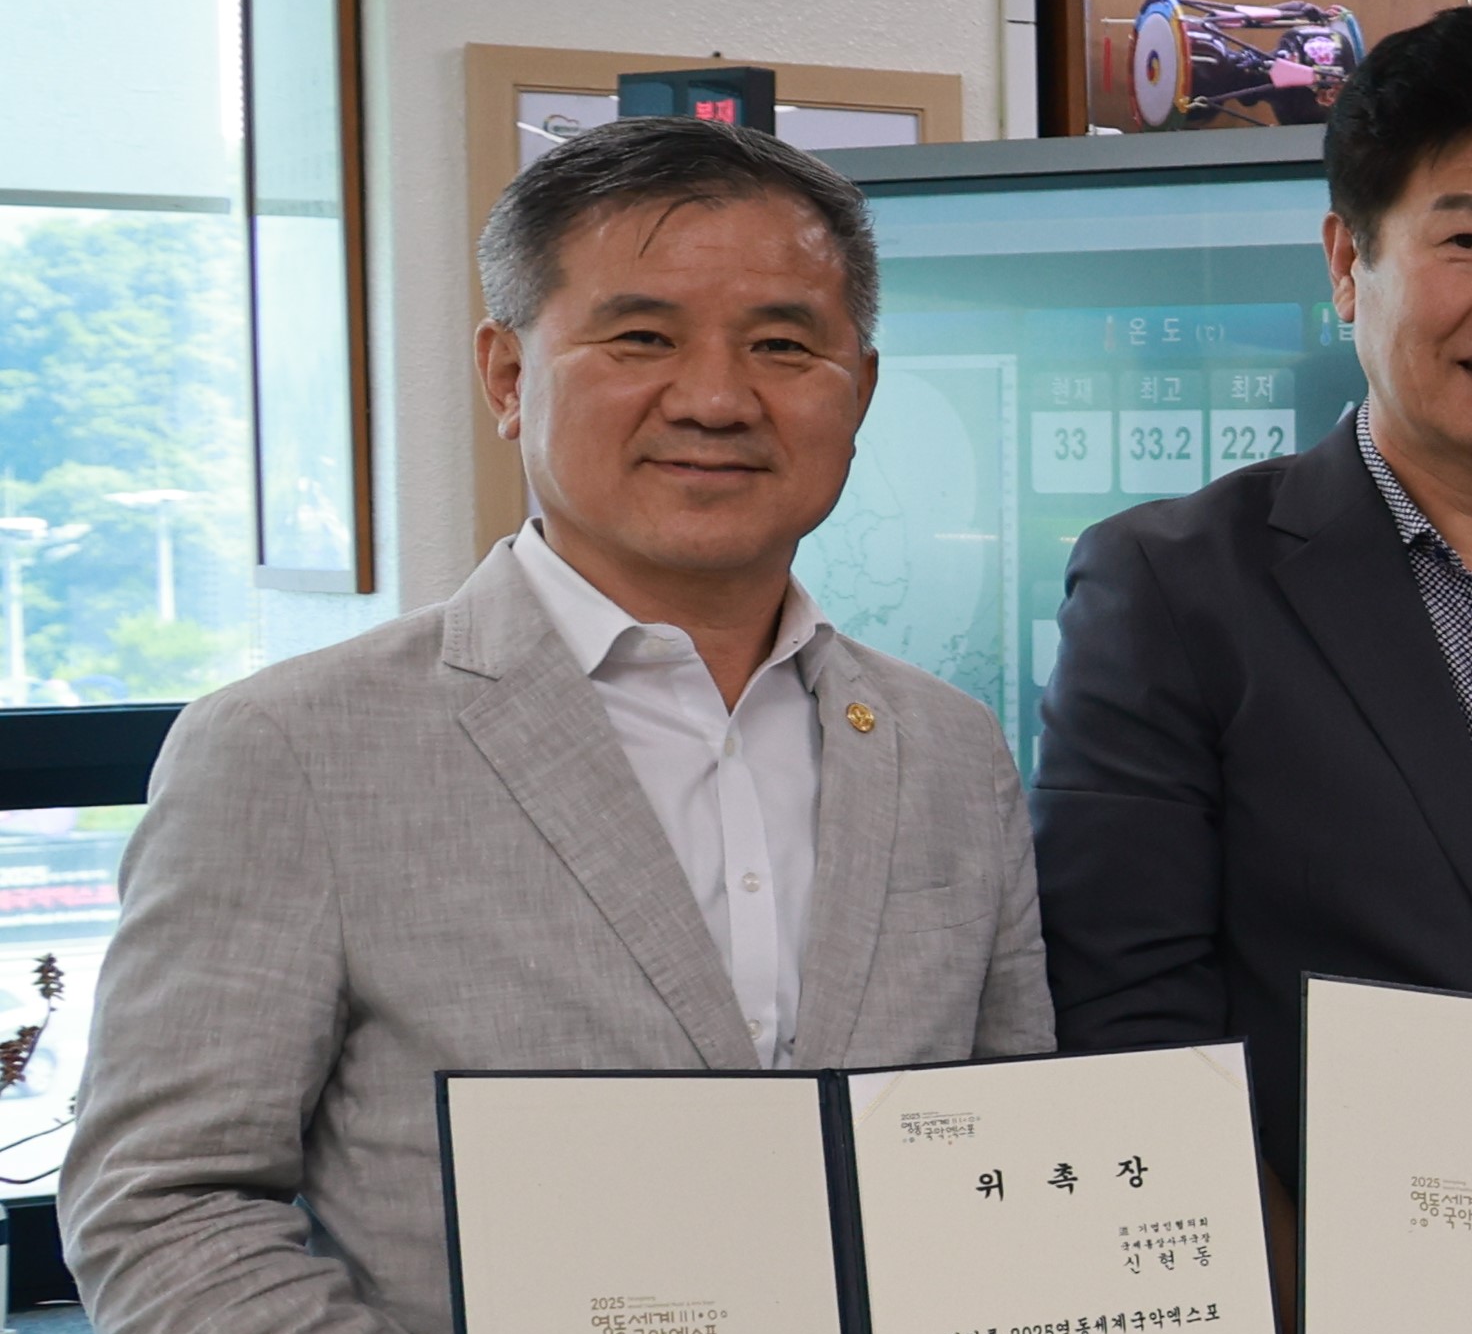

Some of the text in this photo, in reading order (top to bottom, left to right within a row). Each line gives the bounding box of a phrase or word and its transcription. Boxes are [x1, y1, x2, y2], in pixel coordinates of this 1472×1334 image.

[1129, 317, 1147, 346] 온
[1162, 318, 1182, 342] 도
[1051, 378, 1093, 405] 현재
[1140, 376, 1182, 403] 최고
[1231, 373, 1274, 403] 최저
[1054, 427, 1088, 461] 33
[1130, 427, 1191, 460] 33.2
[1221, 425, 1285, 460] 22.2
[976, 1155, 1148, 1201] 위 촉 장
[1411, 1176, 1440, 1188] 2025
[1124, 1246, 1212, 1274] 신 현 동
[591, 1296, 626, 1310] 2025
